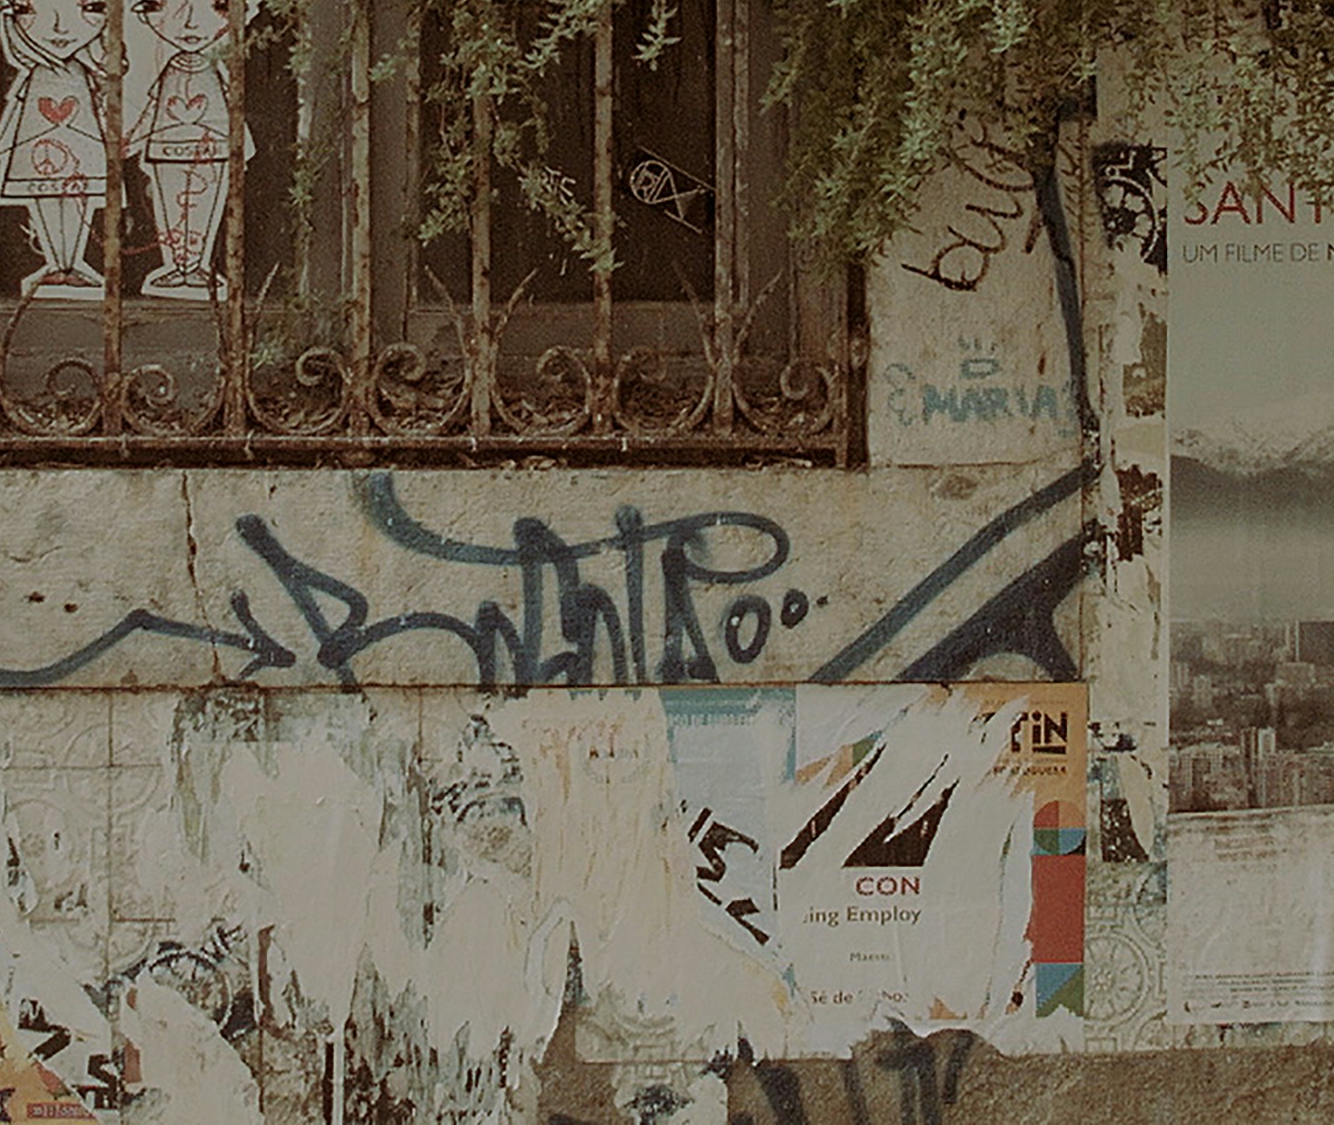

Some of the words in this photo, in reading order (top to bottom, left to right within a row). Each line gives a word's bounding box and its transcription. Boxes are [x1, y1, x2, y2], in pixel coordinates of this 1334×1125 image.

[1182, 244, 1218, 264] UM
[1224, 242, 1283, 263] FILME
[1291, 242, 1318, 263] DE
[855, 876, 922, 897] CON
[846, 906, 923, 926] Employ
